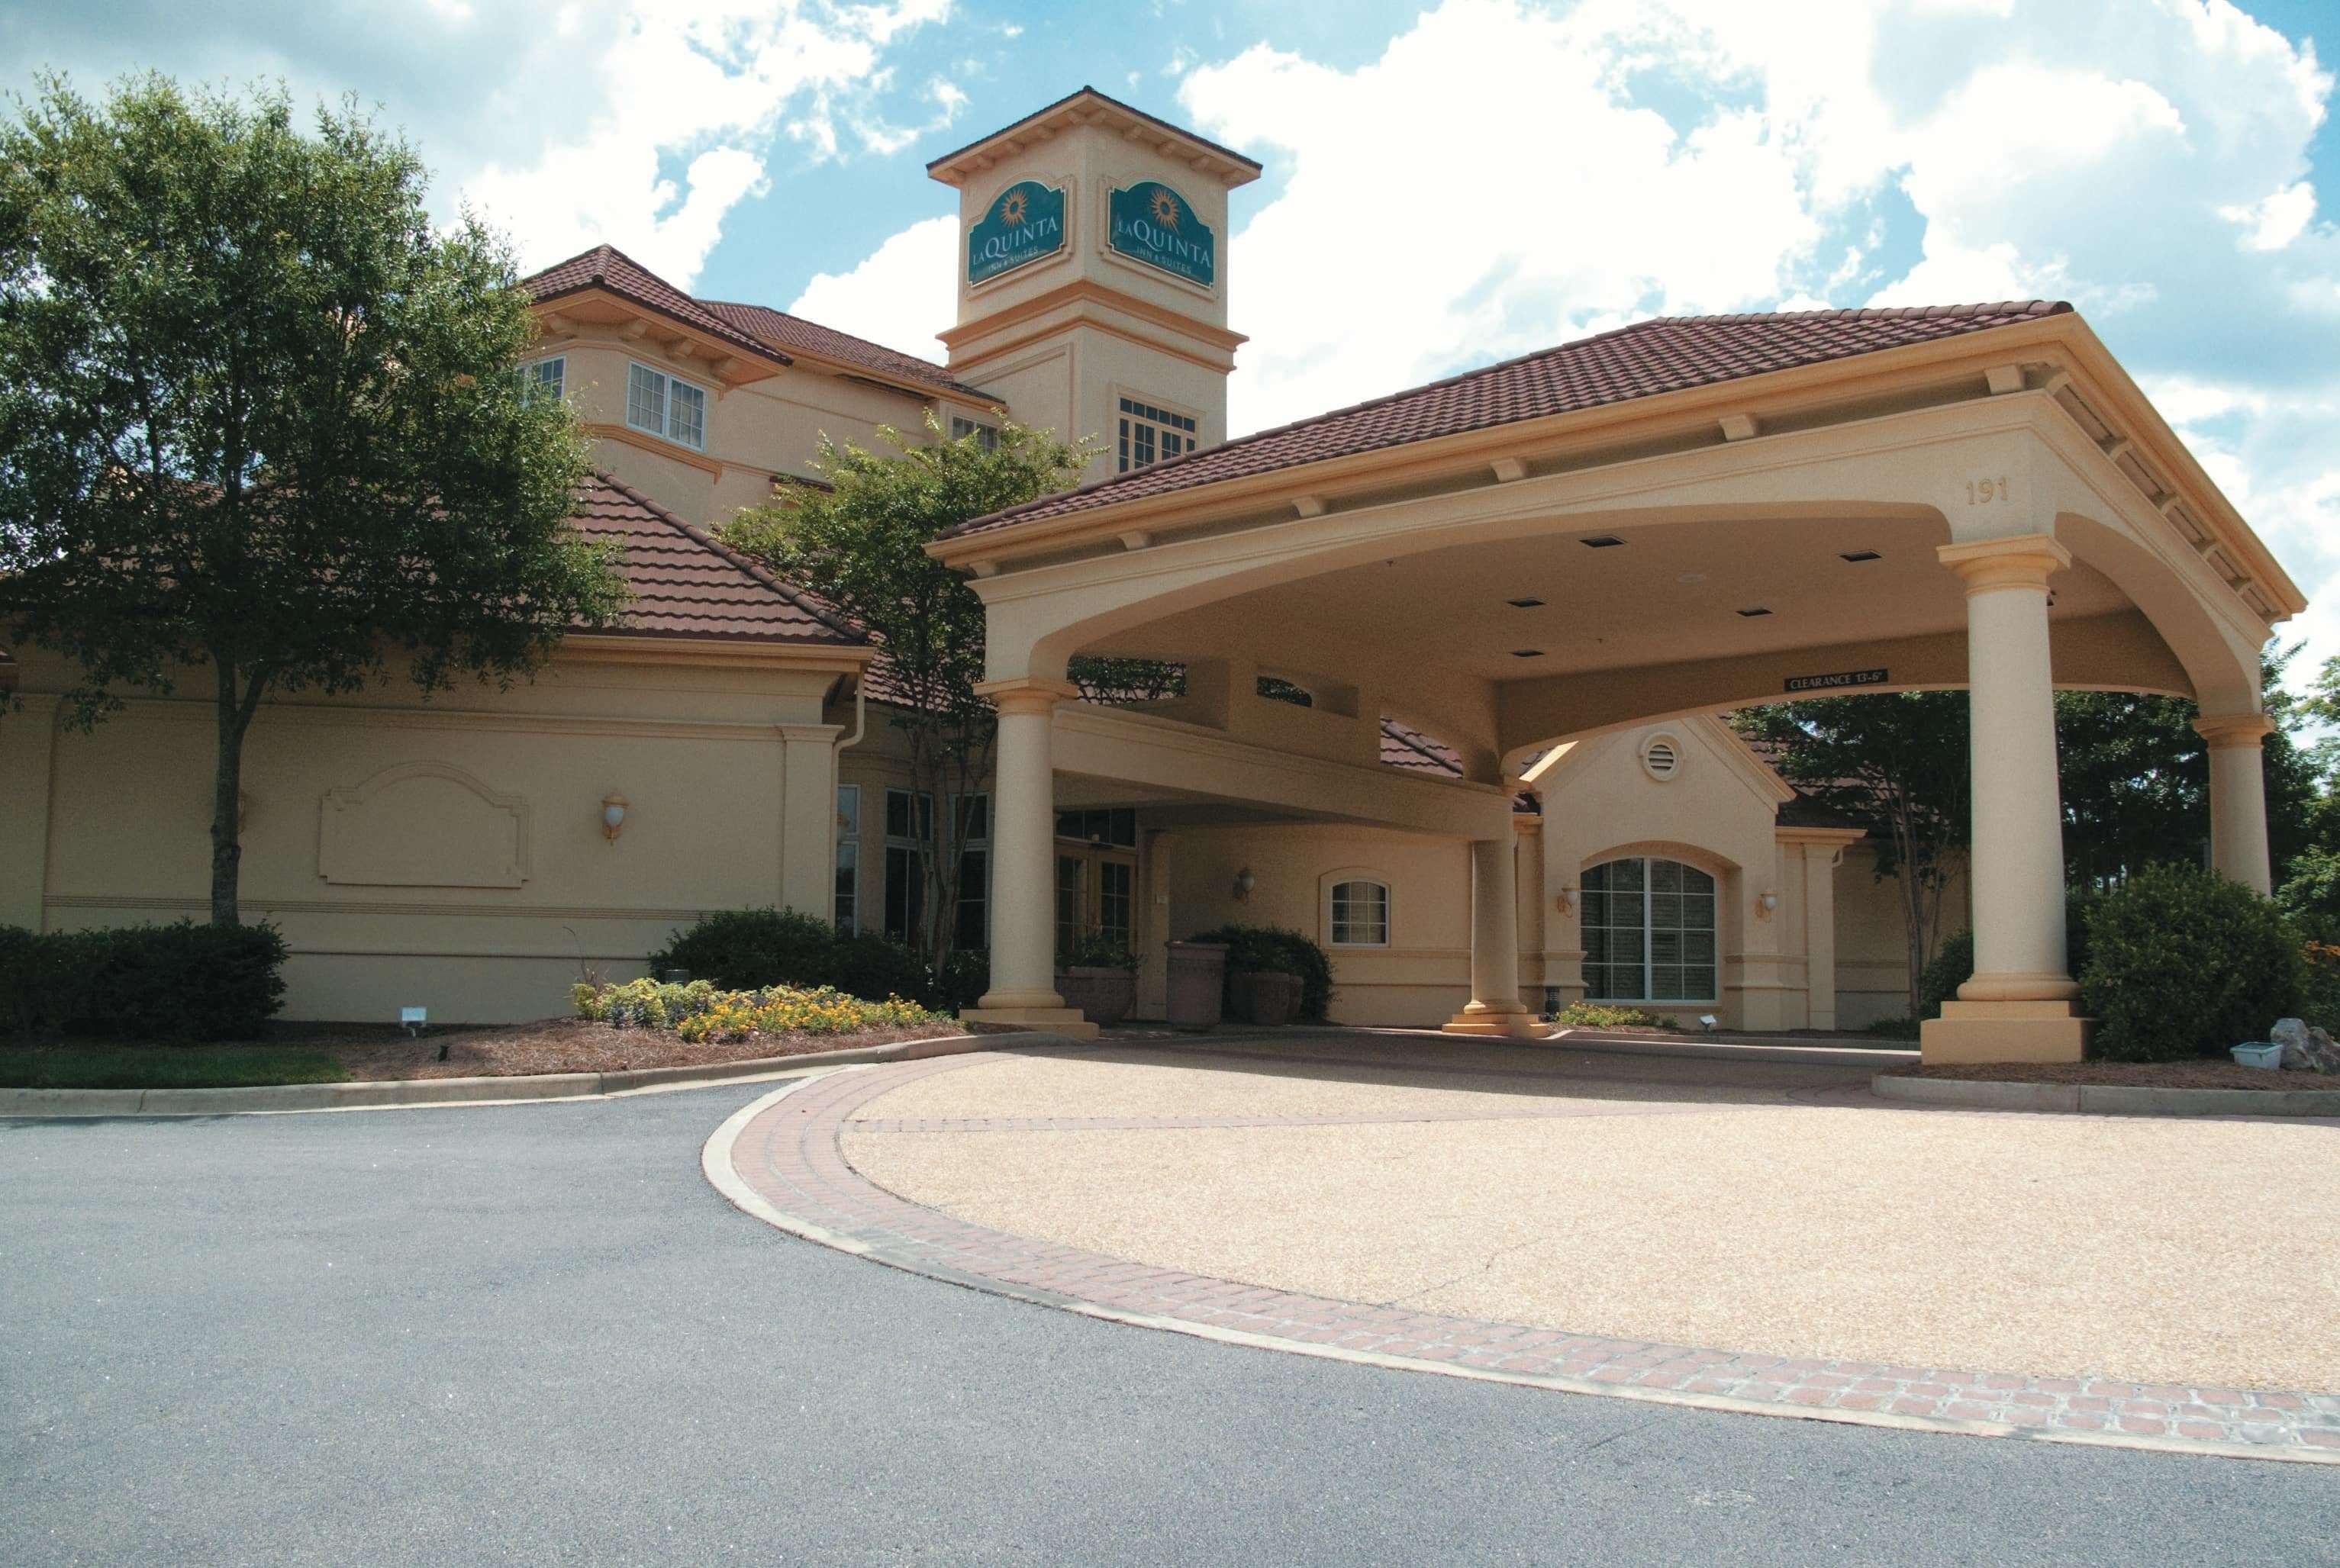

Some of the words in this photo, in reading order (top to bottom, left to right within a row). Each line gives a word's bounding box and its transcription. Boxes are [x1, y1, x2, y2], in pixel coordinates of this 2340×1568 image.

[972, 251, 985, 266] LA
[985, 216, 1058, 258] QUINTA
[1118, 221, 1133, 237] LA
[1133, 220, 1211, 268] QUINTA
[1136, 246, 1152, 259] INN
[1162, 256, 1191, 274] SUITES
[1966, 476, 2009, 505] 191
[1790, 675, 1851, 689] CLEARANCE
